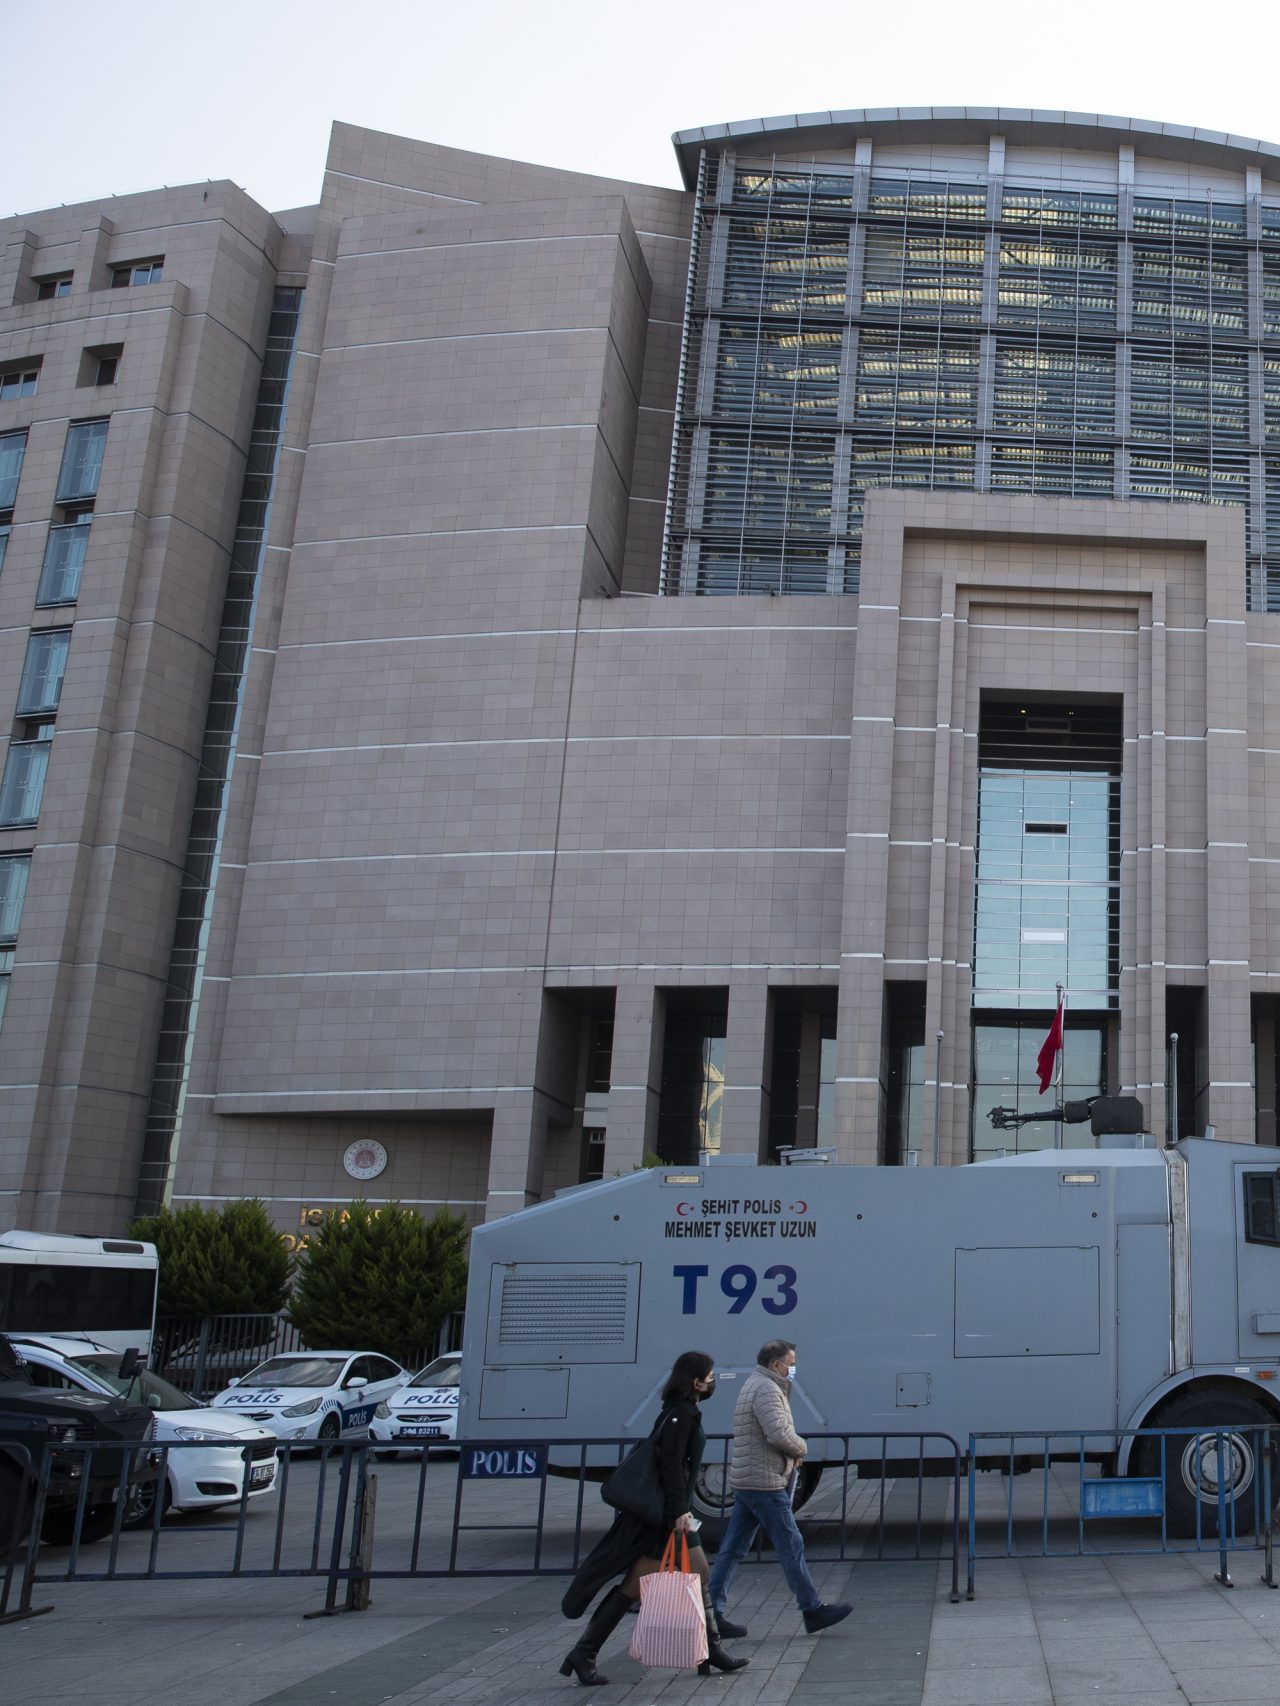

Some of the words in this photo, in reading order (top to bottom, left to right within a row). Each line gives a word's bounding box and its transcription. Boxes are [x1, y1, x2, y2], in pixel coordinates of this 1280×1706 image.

[665, 1221, 721, 1238] MEHMET
[724, 1221, 776, 1242] ŞEVKET
[780, 1221, 817, 1238] UZUN
[673, 1264, 709, 1315] T
[720, 1263, 798, 1316] 93
[223, 1393, 284, 1405] POLİS
[348, 1409, 367, 1427] POLİS
